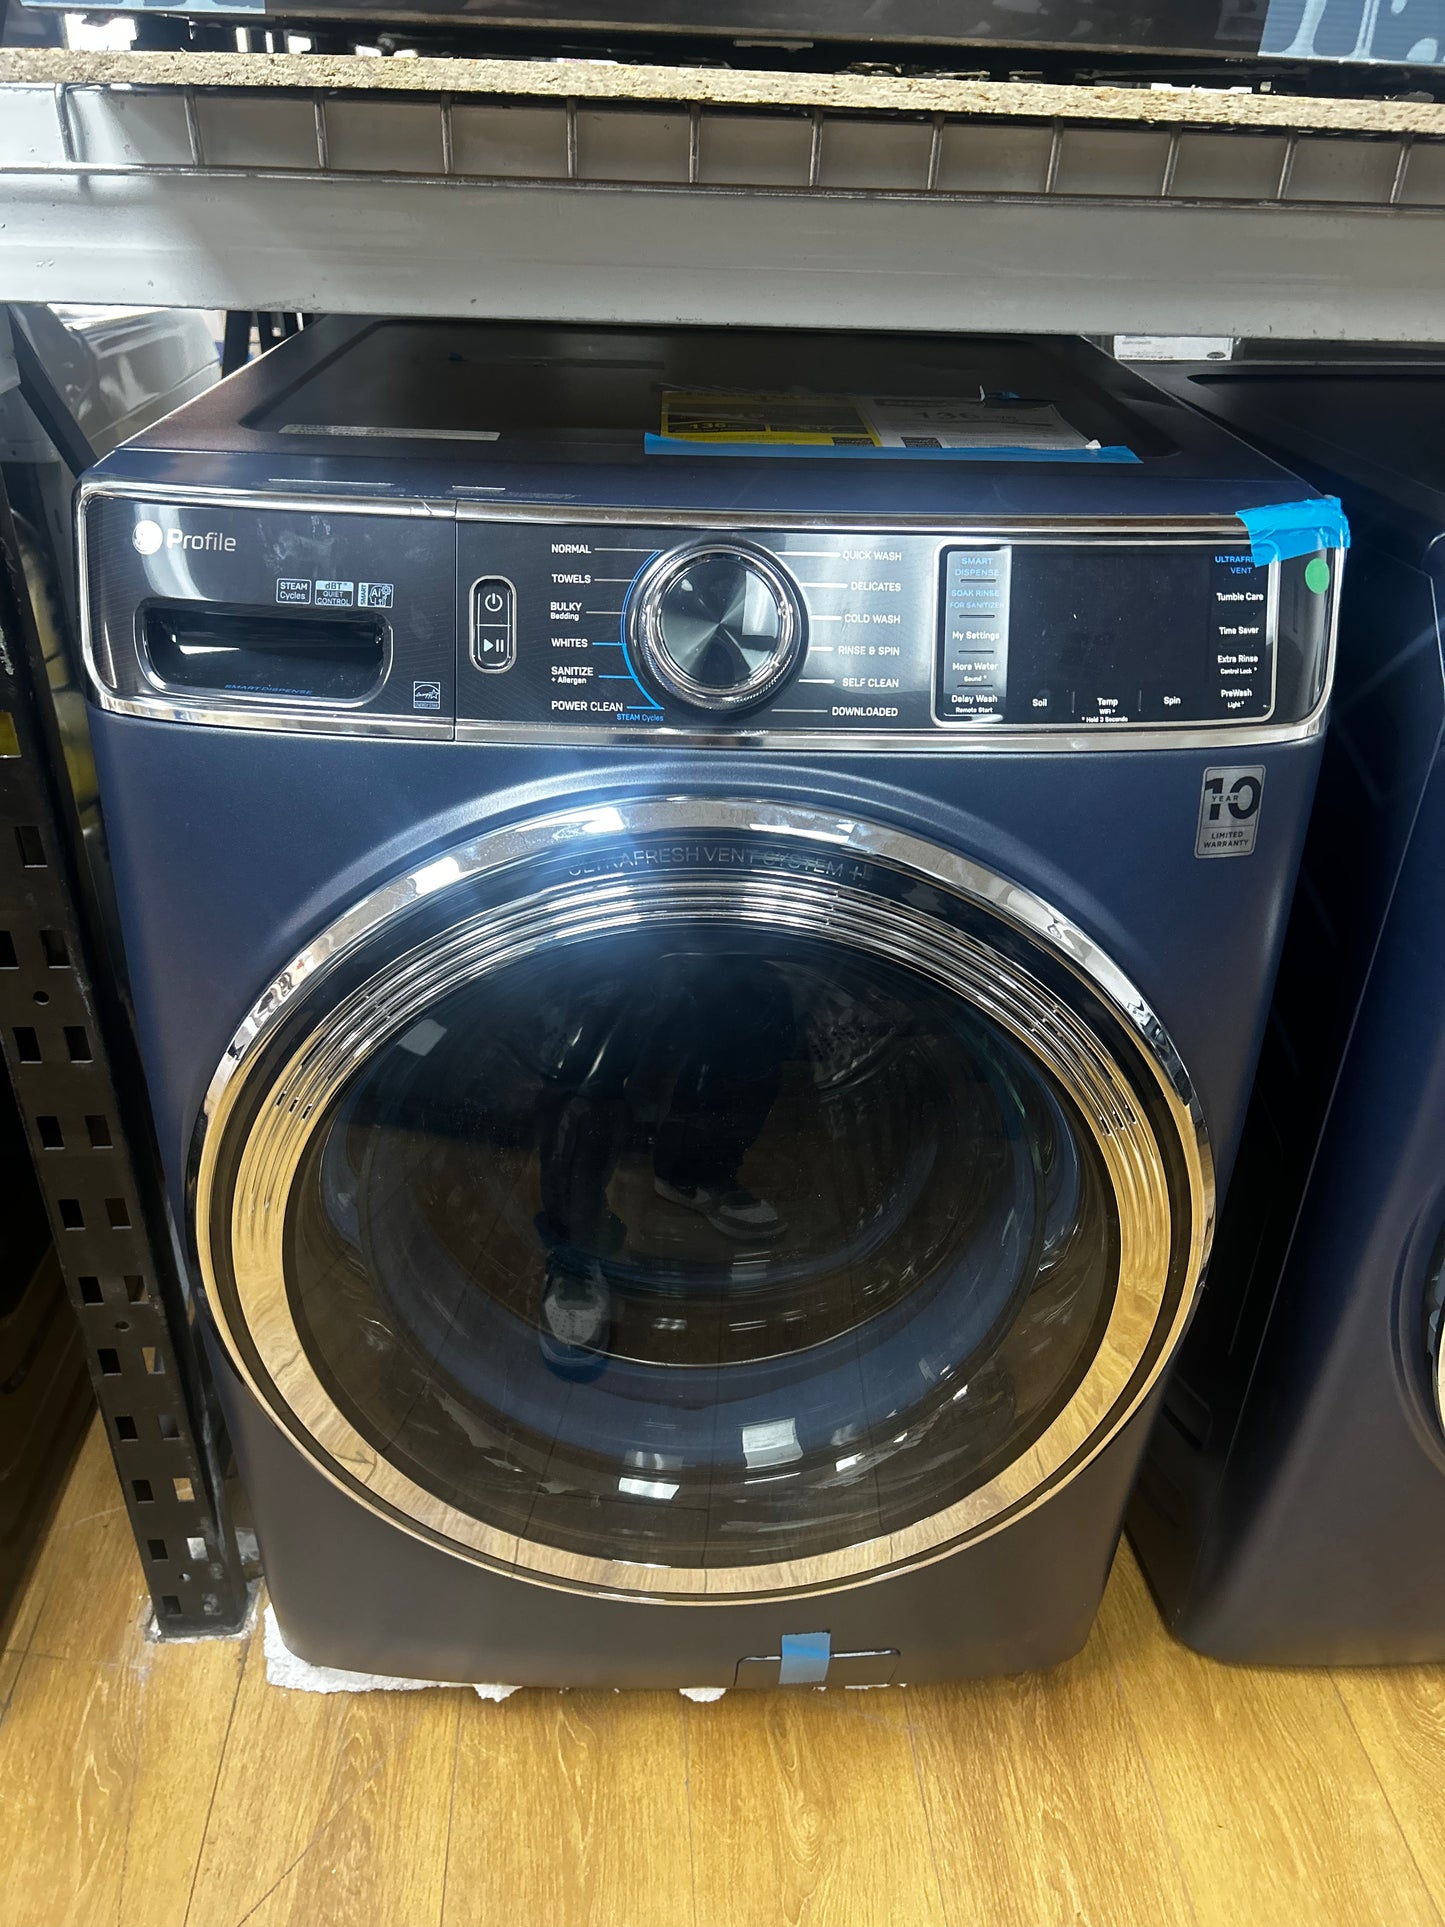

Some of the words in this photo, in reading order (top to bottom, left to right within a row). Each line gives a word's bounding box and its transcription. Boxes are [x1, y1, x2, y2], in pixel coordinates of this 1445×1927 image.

[166, 528, 236, 551] Profile
[551, 544, 591, 553] NORMAL
[842, 550, 871, 560] QUICK
[874, 551, 902, 560] WASH
[1214, 555, 1255, 563] ULTRAFRE
[961, 557, 993, 565] SMART
[955, 568, 1001, 576] DISPENSE
[1230, 566, 1252, 575] VENT
[551, 574, 591, 583] TOWELS
[280, 581, 307, 590] STEAM
[851, 581, 901, 591] DELICATES
[280, 591, 305, 600] Cycles
[951, 589, 974, 597] SOAK
[975, 589, 1000, 597] RINSE
[1216, 592, 1245, 601] Tumble
[1245, 592, 1264, 601] Care
[317, 597, 349, 605] CONTROL
[950, 601, 965, 609] FOR
[550, 602, 582, 611] BULKY
[550, 612, 579, 621] Bedding
[844, 613, 870, 623] COLD
[872, 614, 901, 624] WASH
[1219, 626, 1237, 635] Time
[1238, 626, 1259, 635] Saver
[952, 631, 964, 641] My
[965, 631, 1000, 641] Settings
[551, 638, 588, 647] WHITES
[838, 645, 866, 655] RINSE
[868, 646, 876, 655] &
[878, 646, 900, 656] SPIN
[1217, 655, 1237, 663] Extra
[1238, 654, 1258, 663] Rinse
[551, 666, 593, 676] SANITIZE
[952, 662, 972, 671] More
[974, 662, 999, 671] Water
[557, 677, 587, 685] Allergen
[842, 677, 866, 687] SELF
[868, 678, 899, 688] CLEAN
[261, 686, 312, 695] DISPENSE
[1220, 688, 1253, 698] PreWash
[951, 694, 974, 704] Delay
[975, 694, 998, 703] Wash
[1032, 698, 1048, 707] Soil
[1097, 697, 1118, 707] Temp
[1163, 696, 1181, 706] Spin
[551, 701, 587, 710] POWER
[590, 702, 623, 711] CLEAN
[832, 706, 899, 717] DOWNLOADED
[616, 713, 640, 721] STEAM
[641, 714, 664, 722] Cycles
[1205, 776, 1262, 820] 10
[1212, 795, 1239, 803] YEAR
[1211, 831, 1243, 840] LIMITED
[1203, 840, 1249, 849] WARRANTY
[703, 847, 754, 864] VENT
